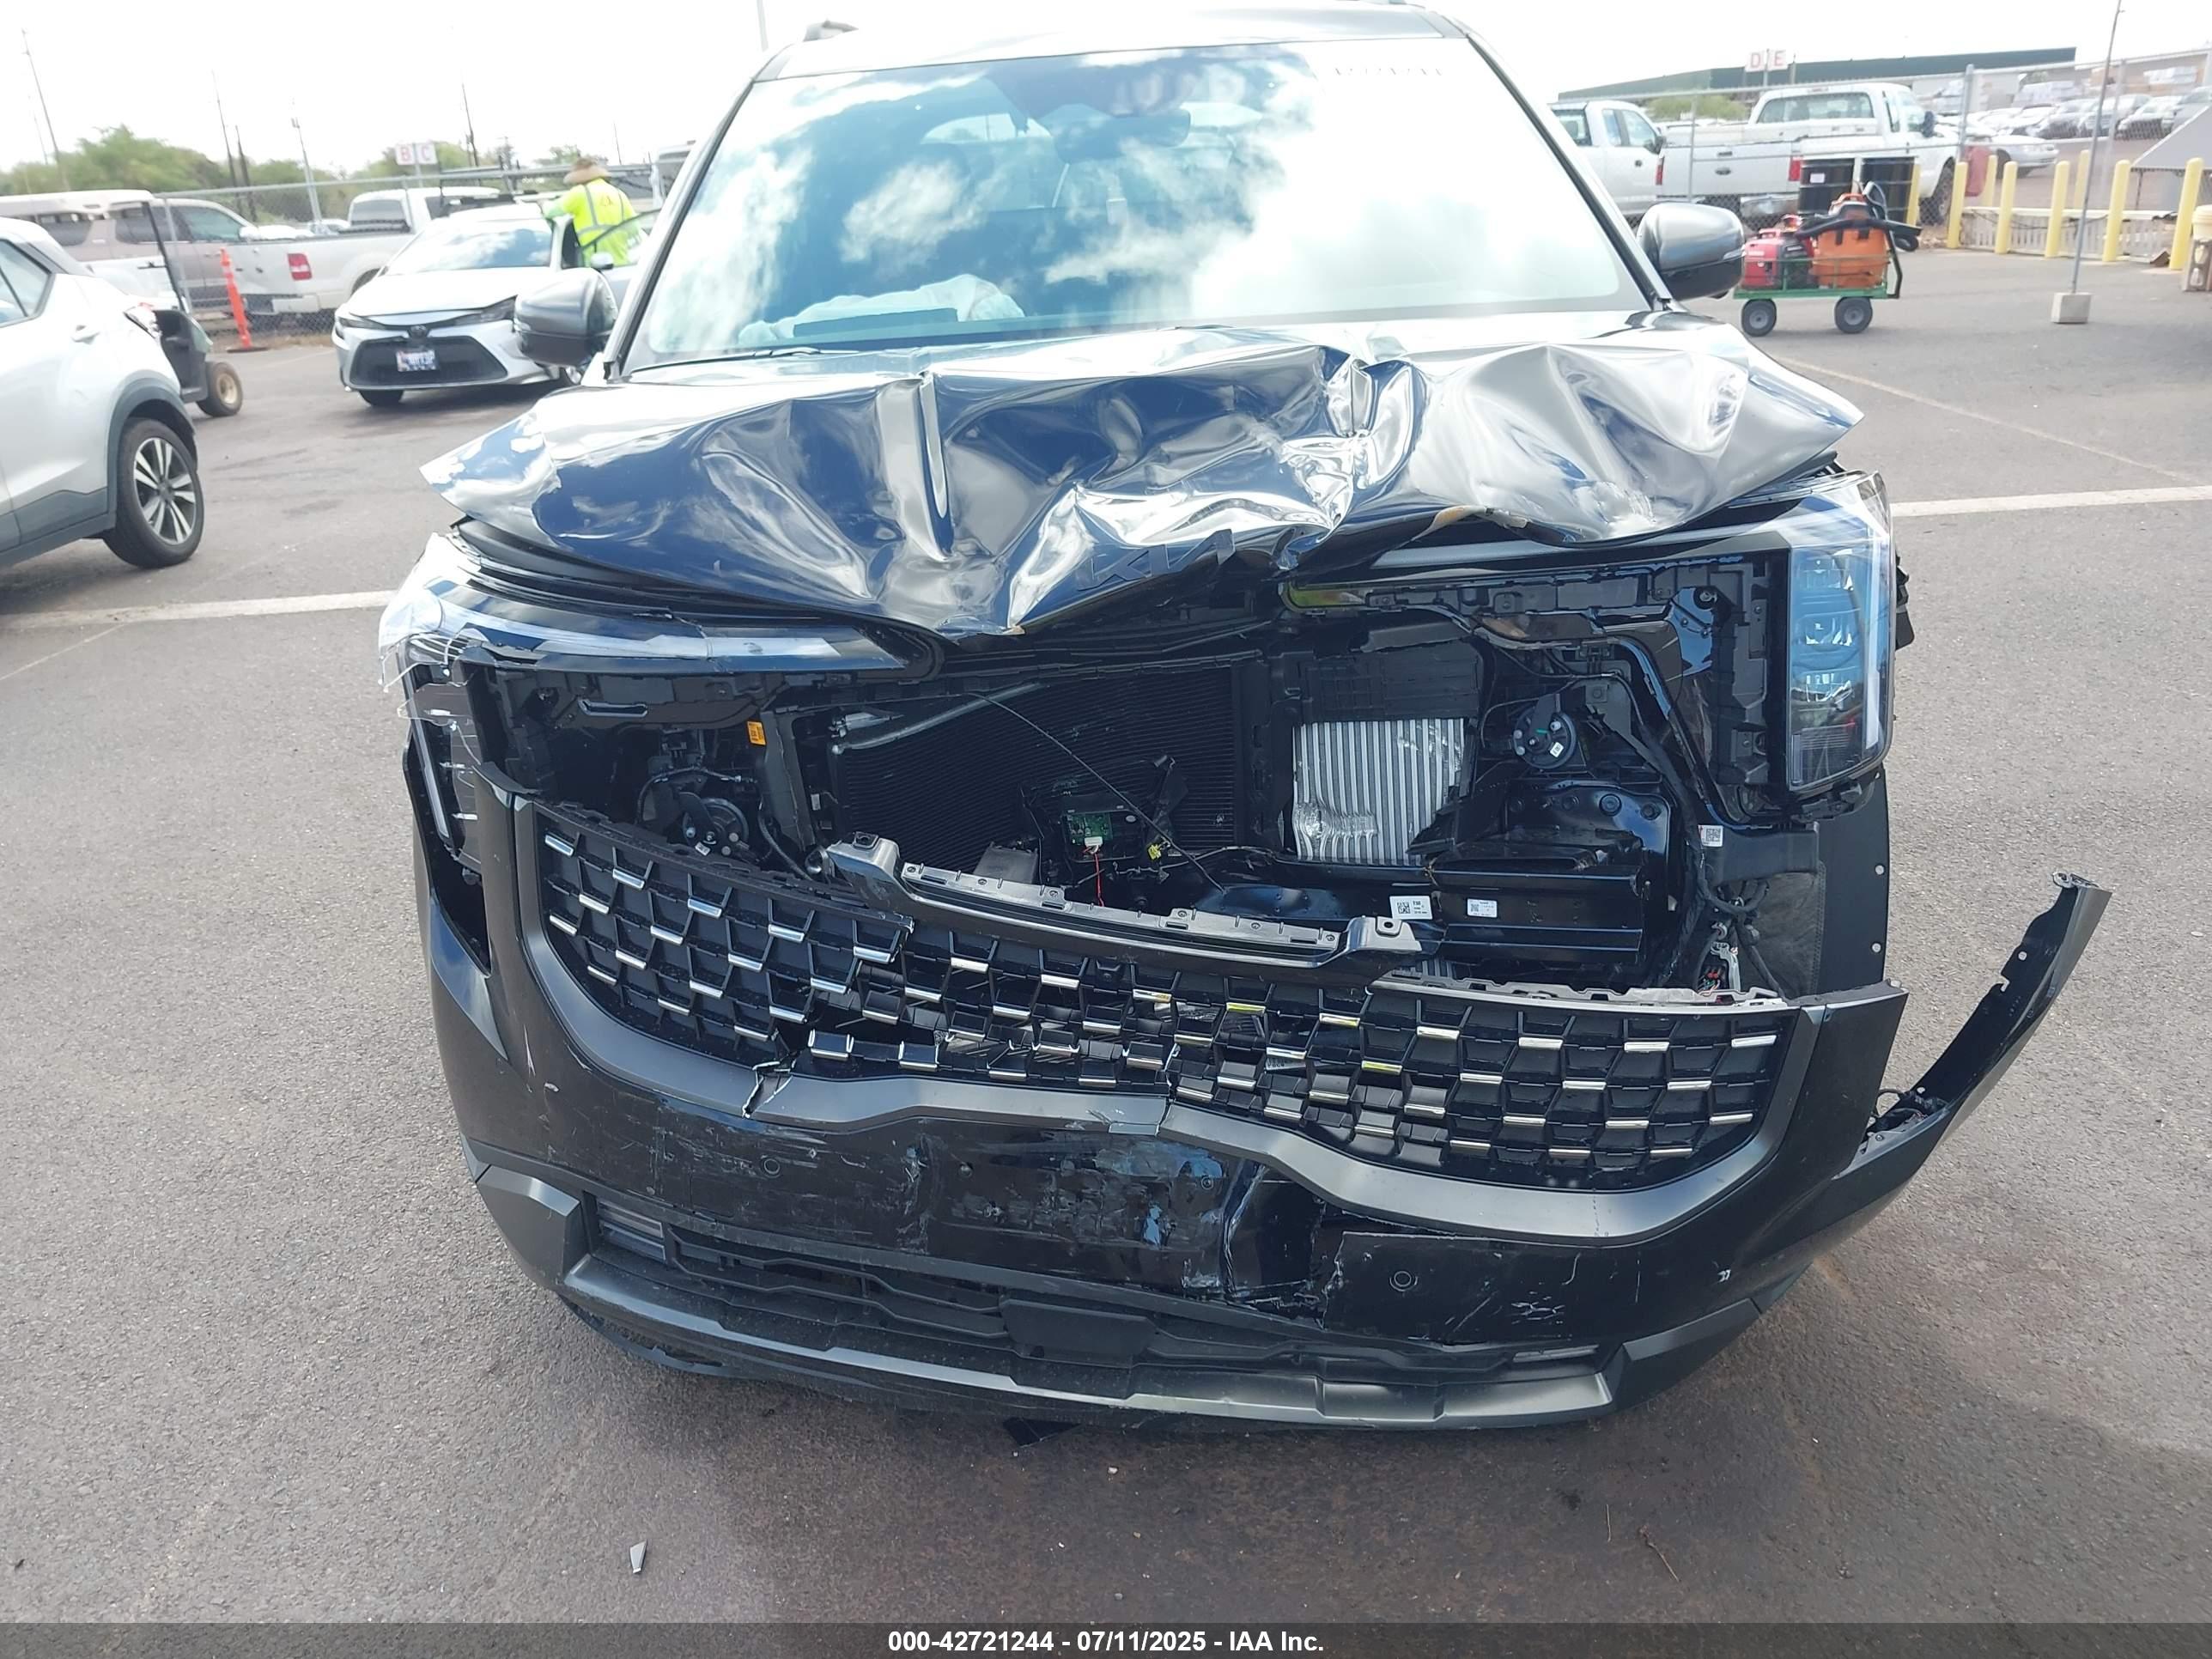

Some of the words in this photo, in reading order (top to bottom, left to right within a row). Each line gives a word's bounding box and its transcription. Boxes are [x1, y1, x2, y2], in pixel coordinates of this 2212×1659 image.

[1750, 52, 1761, 68] D
[1773, 50, 1785, 66] E
[399, 146, 411, 161] B
[1076, 529, 1236, 592] KIA
